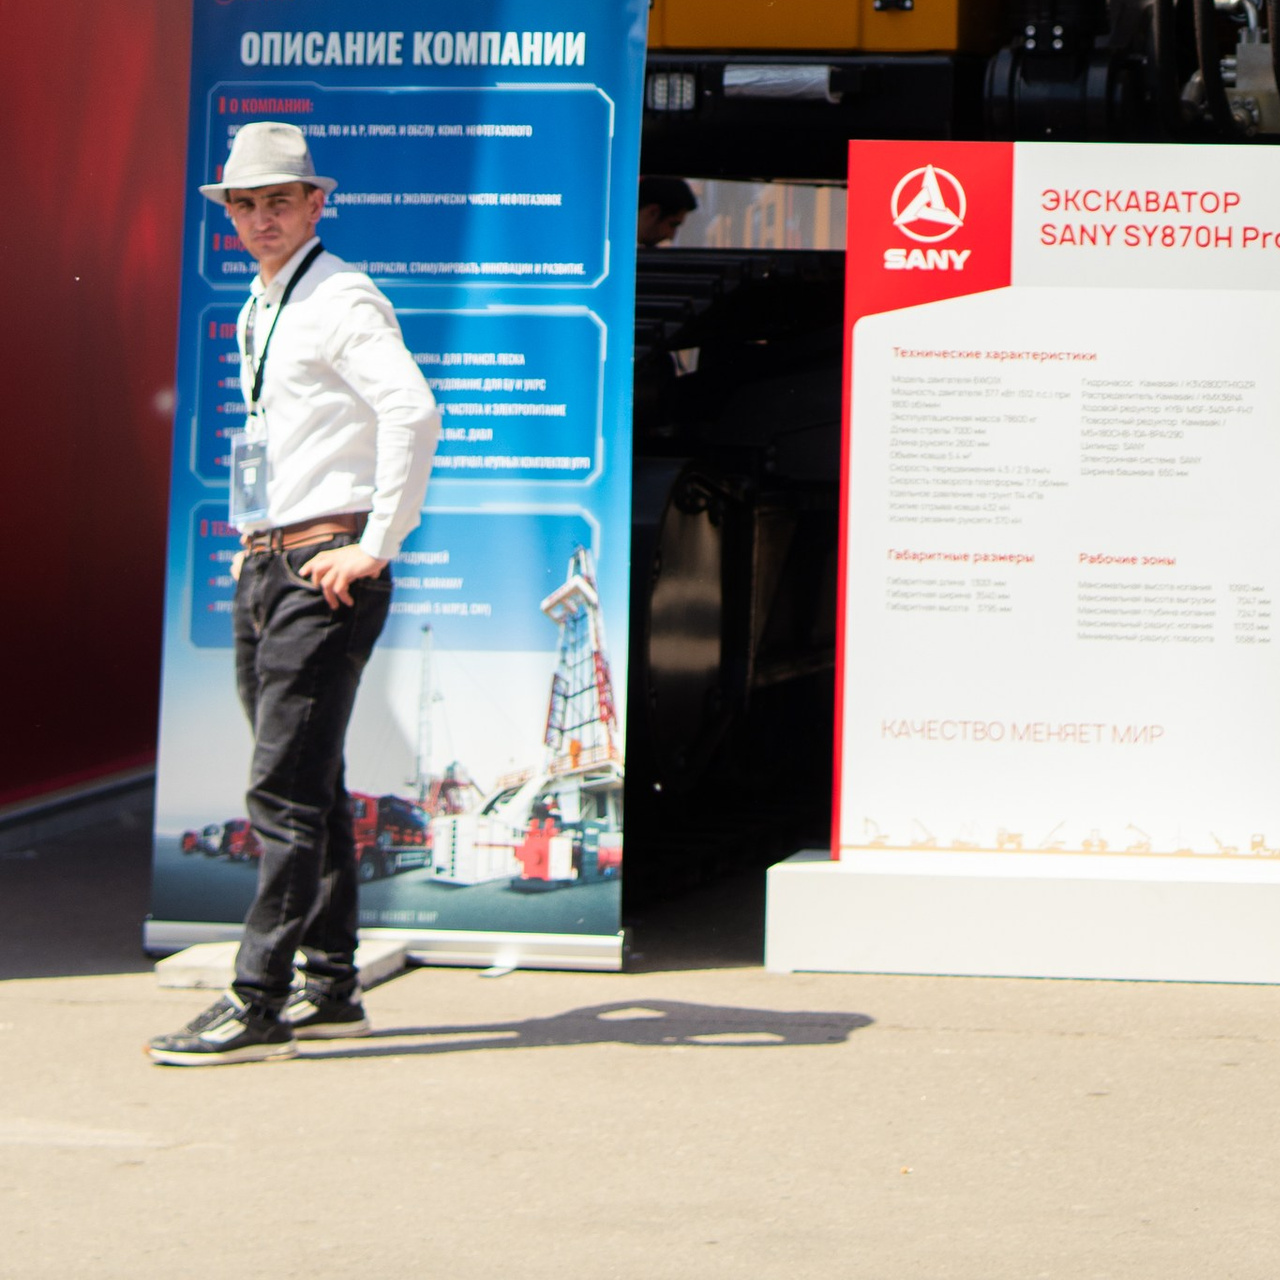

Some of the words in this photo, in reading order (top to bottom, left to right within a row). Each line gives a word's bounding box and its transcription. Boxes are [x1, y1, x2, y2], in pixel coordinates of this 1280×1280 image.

[241, 32, 403, 65] ОПИСАНИЕ
[413, 31, 586, 66] КОМПАНИИ
[241, 98, 313, 114] КОМПАНИИ:
[1041, 189, 1241, 214] ЭКСКАВАТОР
[1041, 223, 1116, 247] SANY
[1124, 223, 1233, 249] SY870H
[884, 249, 972, 271] SANY
[892, 346, 981, 360] Технические
[985, 350, 1097, 363] характеристики
[888, 549, 970, 562] Габаритные
[973, 553, 1035, 565] размеры
[1079, 552, 1138, 565] Рабочие
[1142, 555, 1176, 567] зоны
[881, 718, 1006, 741] КАЧЕСТВО
[1010, 721, 1105, 743] МЕНЯЕТ
[1112, 723, 1166, 744] МИР
